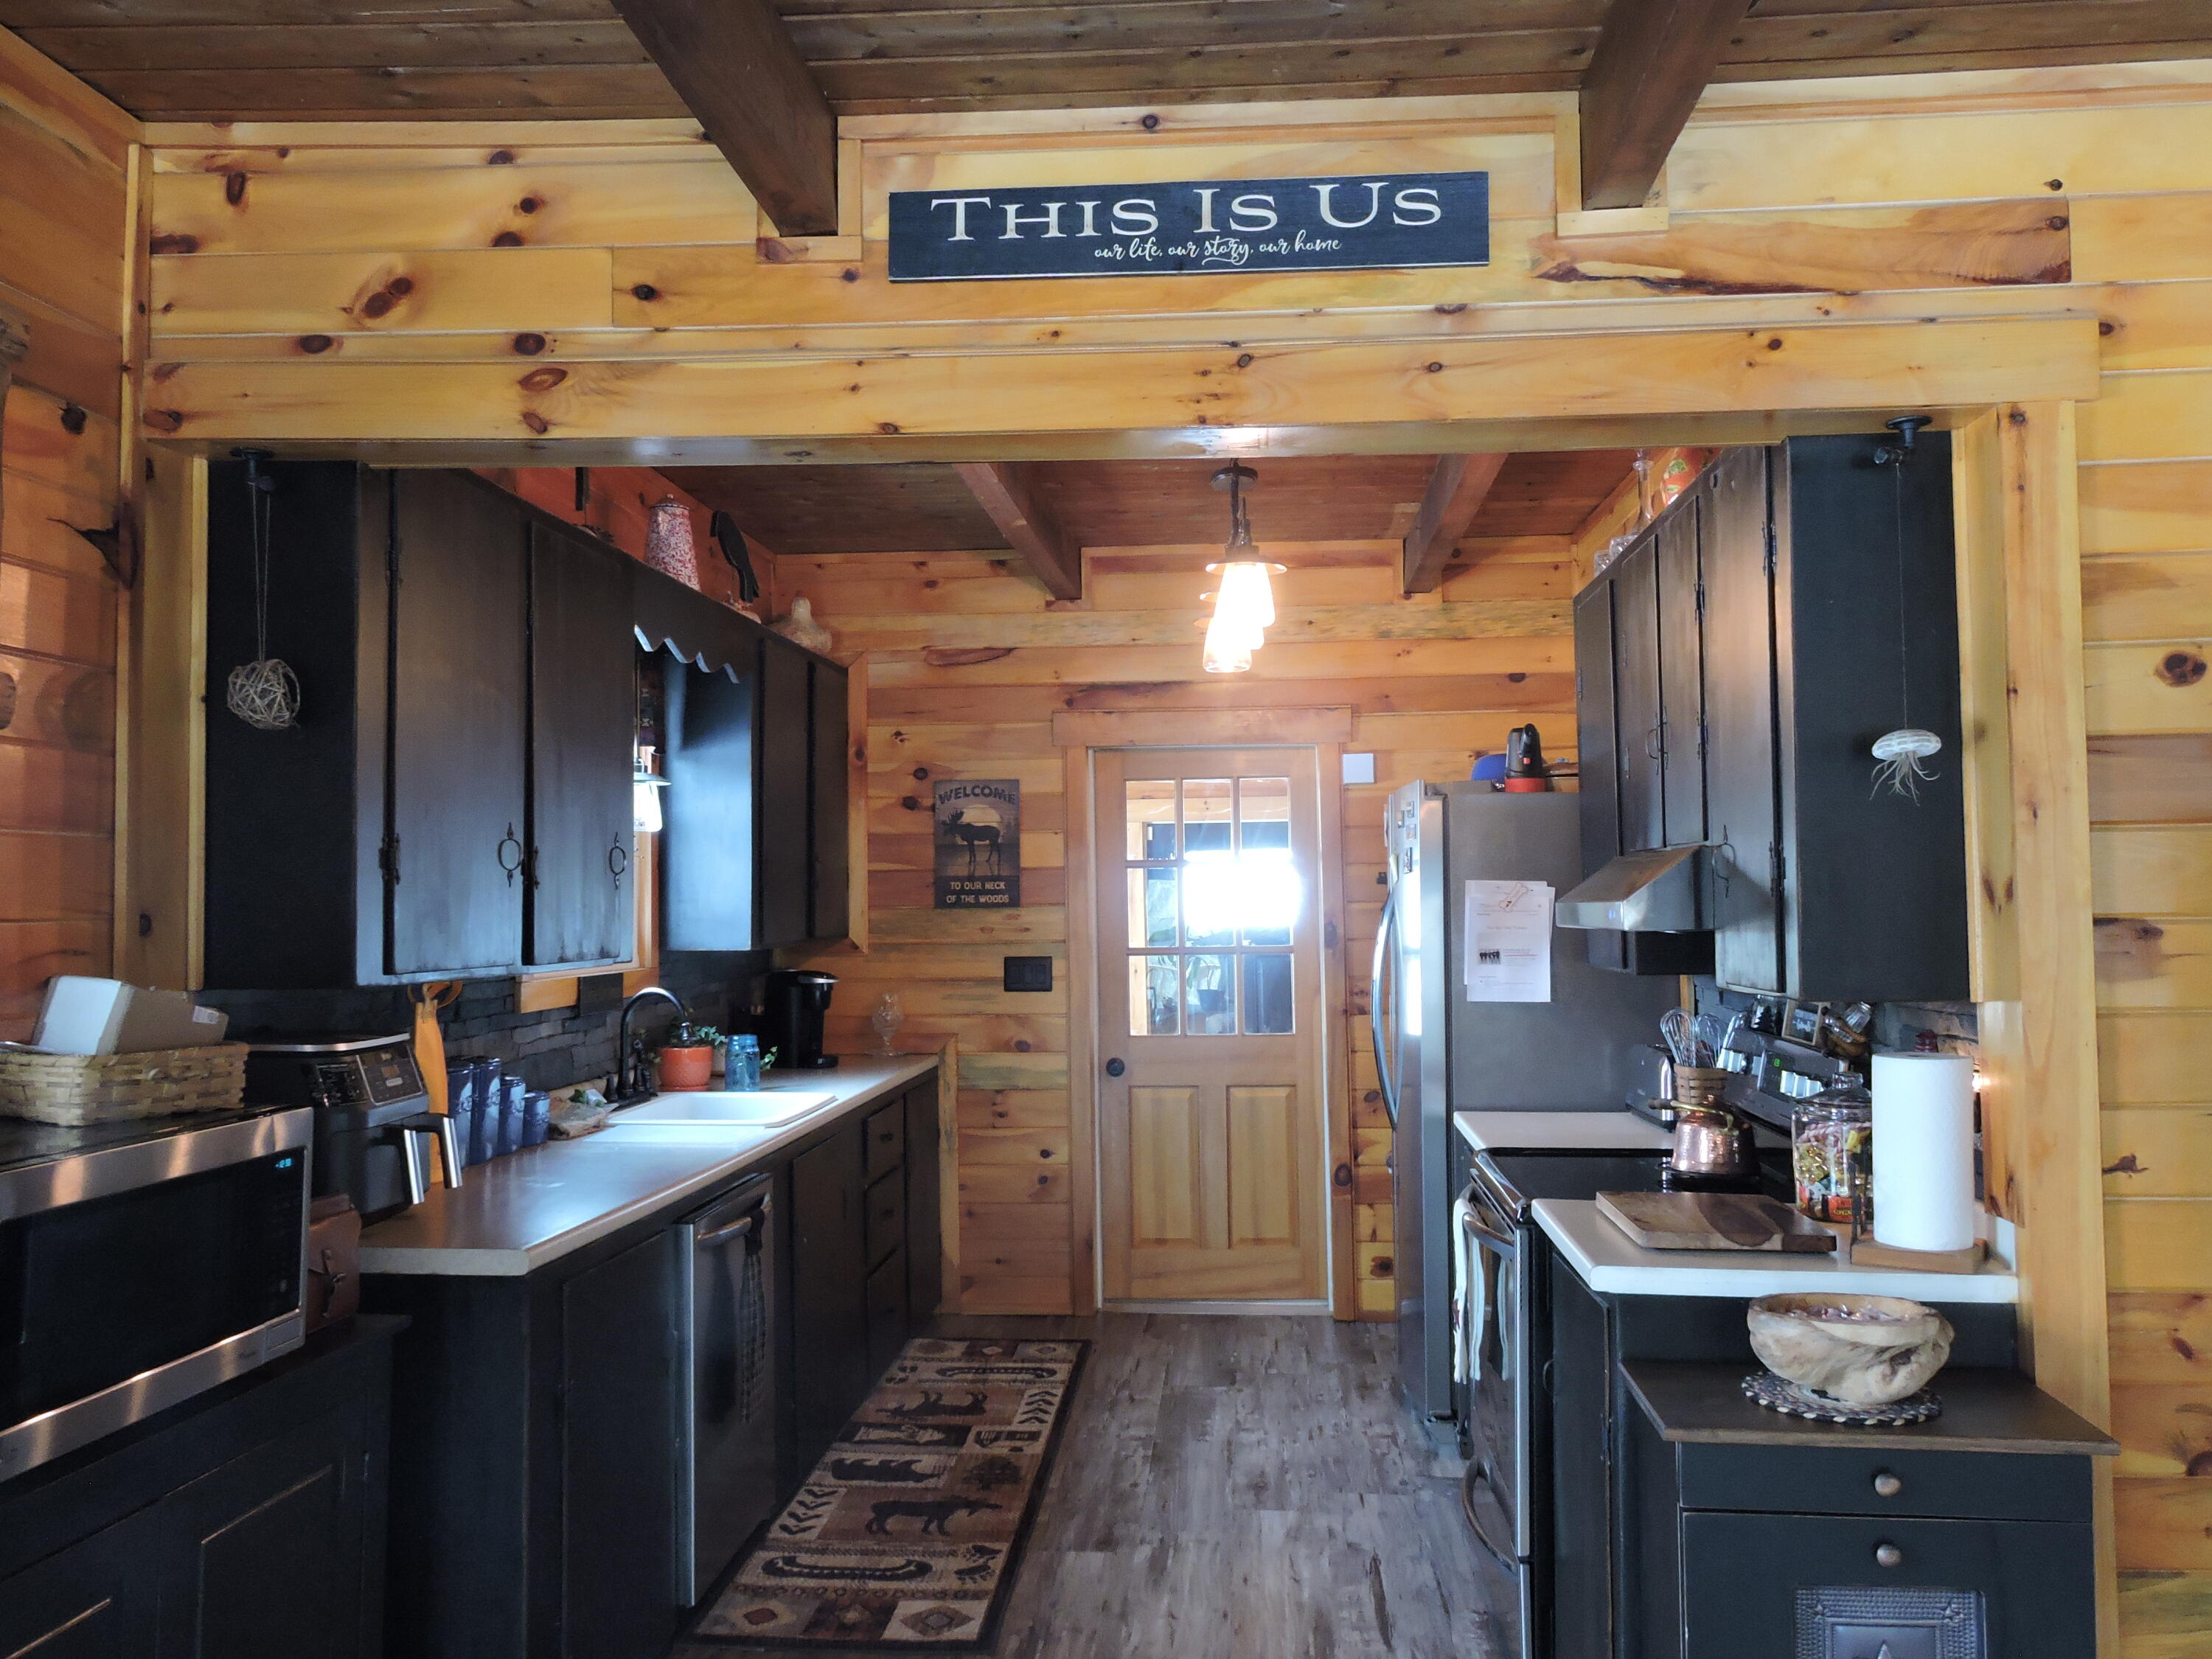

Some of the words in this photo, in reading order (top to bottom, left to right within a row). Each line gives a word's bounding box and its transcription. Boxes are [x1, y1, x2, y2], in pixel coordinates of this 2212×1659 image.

[931, 197, 1159, 241] THIS
[1192, 189, 1279, 233] IS
[1309, 182, 1441, 229] US
[1094, 244, 1126, 260] our
[1129, 237, 1163, 262] life,
[1168, 242, 1200, 258] our
[1259, 239, 1290, 254] our
[1295, 229, 1342, 252] home
[939, 785, 1015, 805] WELCOME
[950, 882, 961, 890] TO
[964, 882, 982, 890] OUR
[984, 881, 1006, 889] NECK
[946, 895, 957, 903] OF
[961, 895, 975, 903] THE
[979, 894, 1009, 903] WOODS
